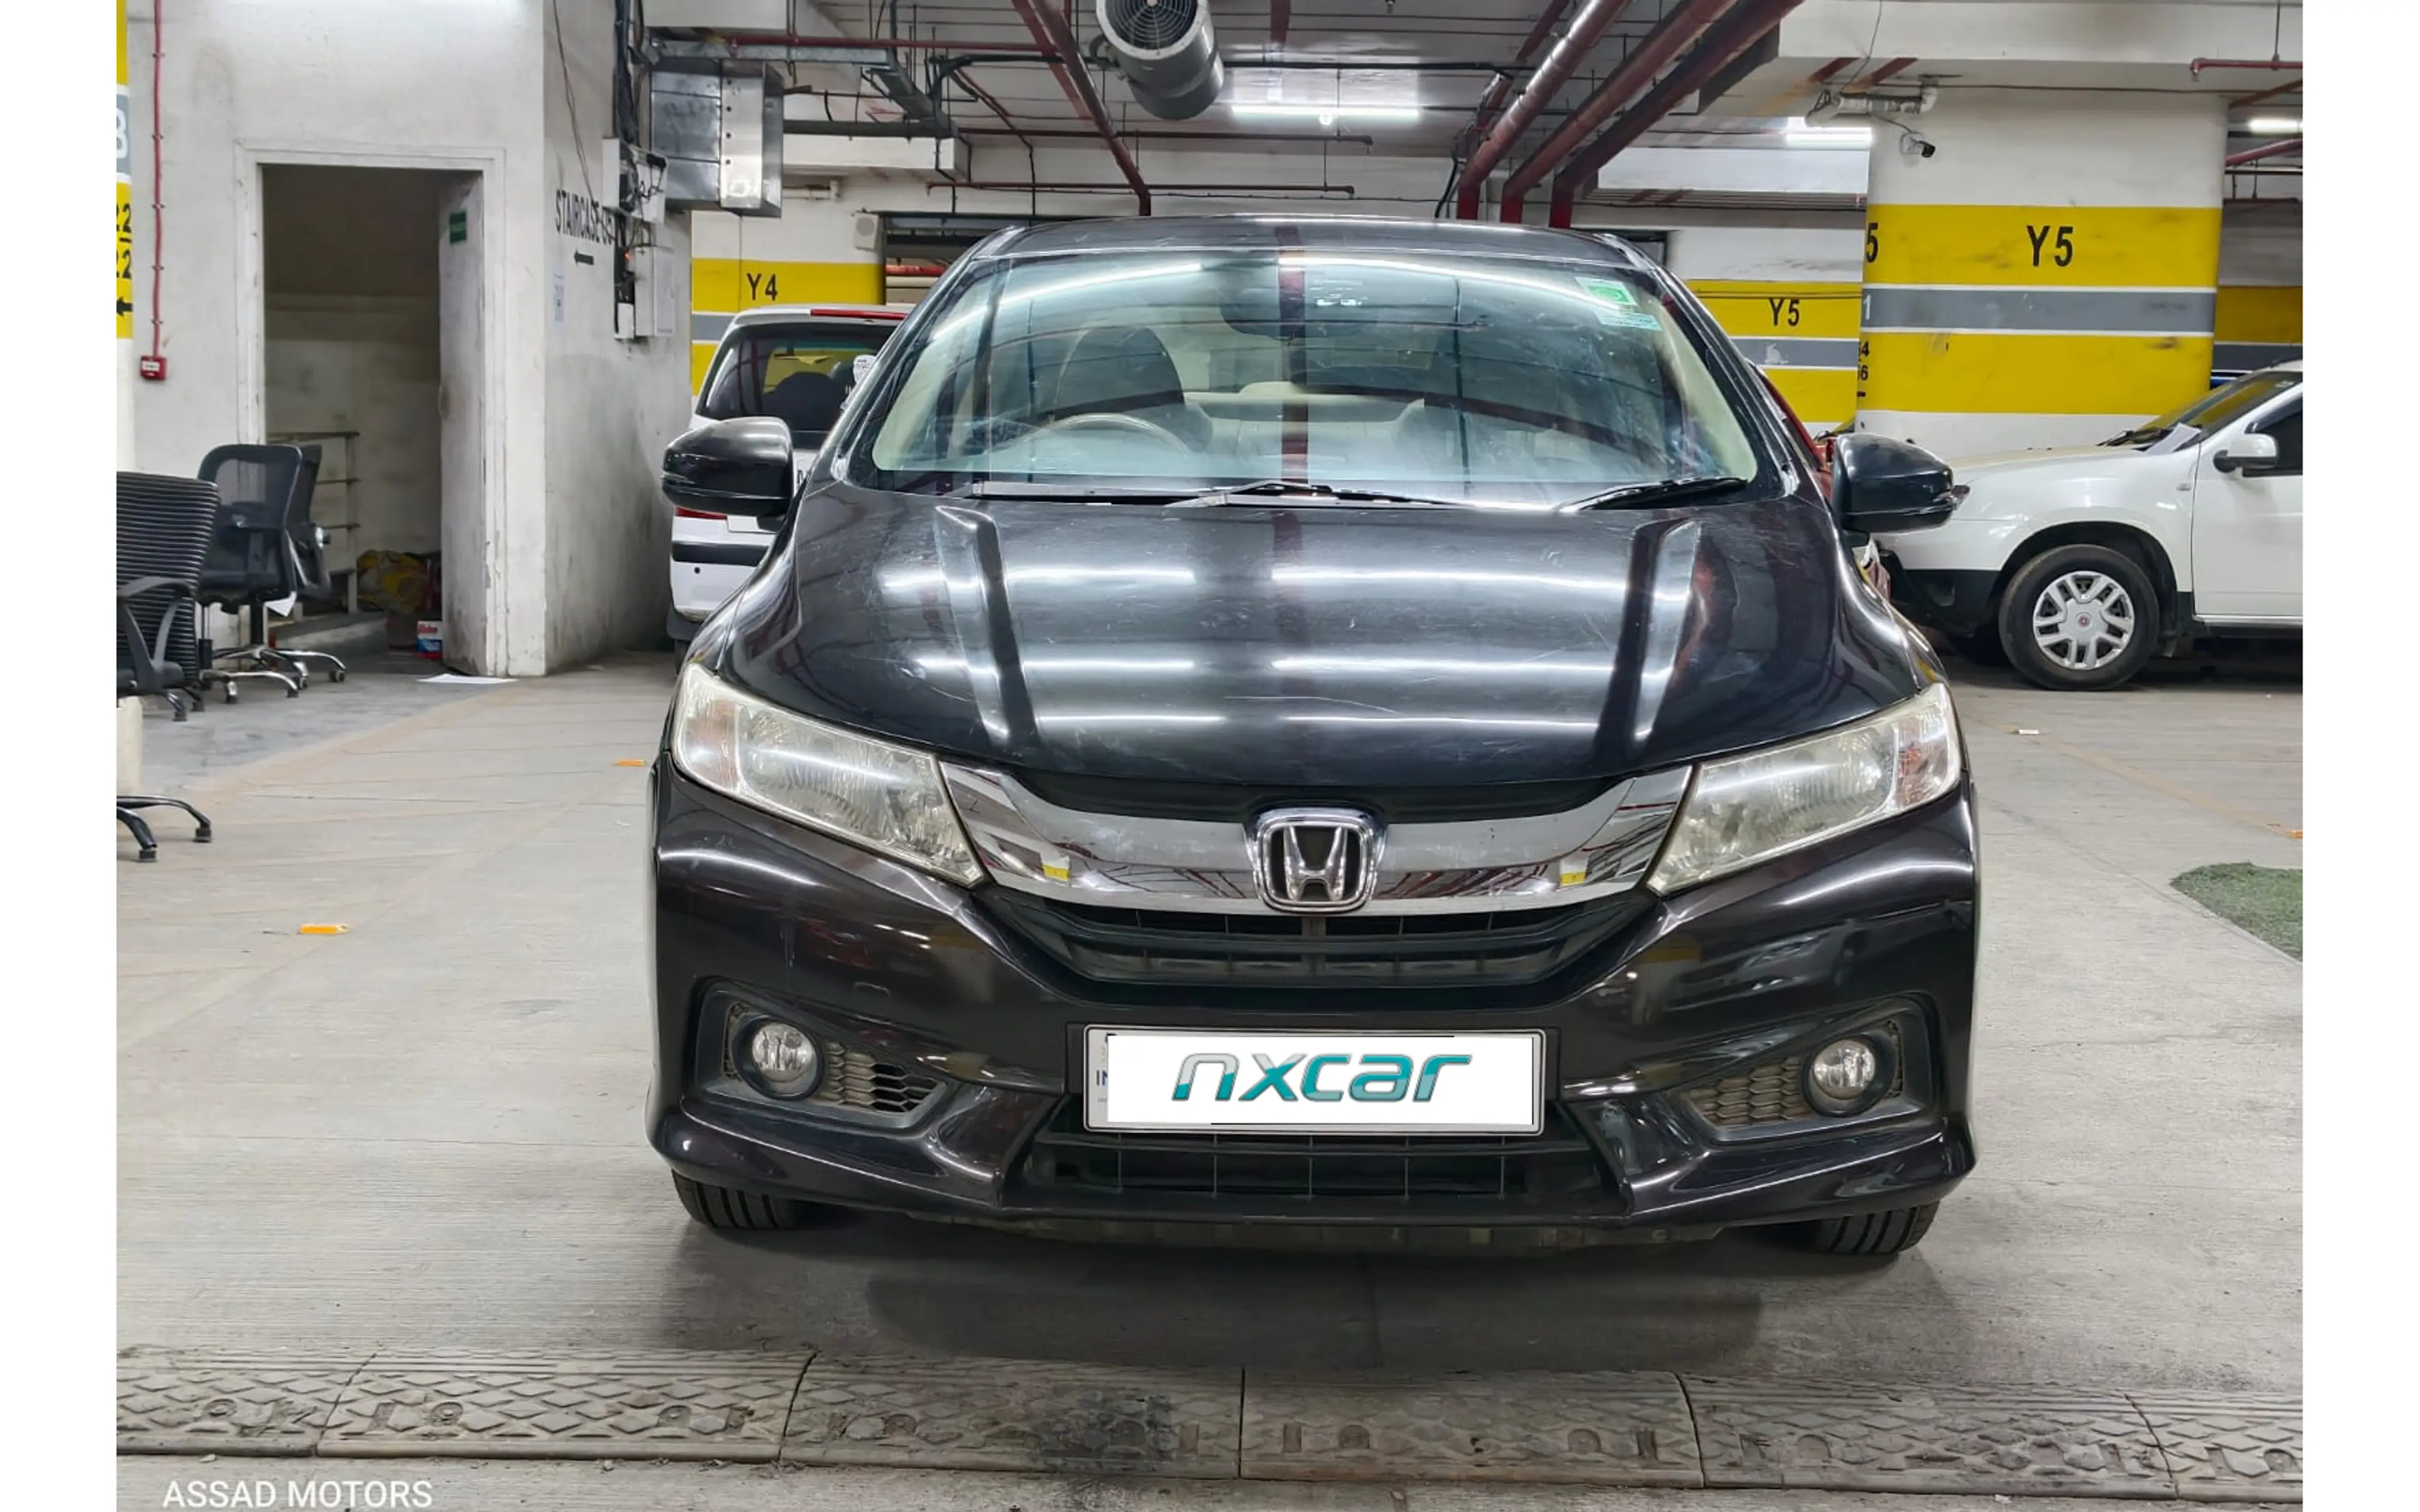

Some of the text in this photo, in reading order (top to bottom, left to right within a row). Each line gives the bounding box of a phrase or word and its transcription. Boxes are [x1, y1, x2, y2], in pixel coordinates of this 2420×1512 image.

[2026, 225, 2073, 267] Y5
[746, 272, 778, 302] Y4
[1768, 297, 1800, 327] Y5
